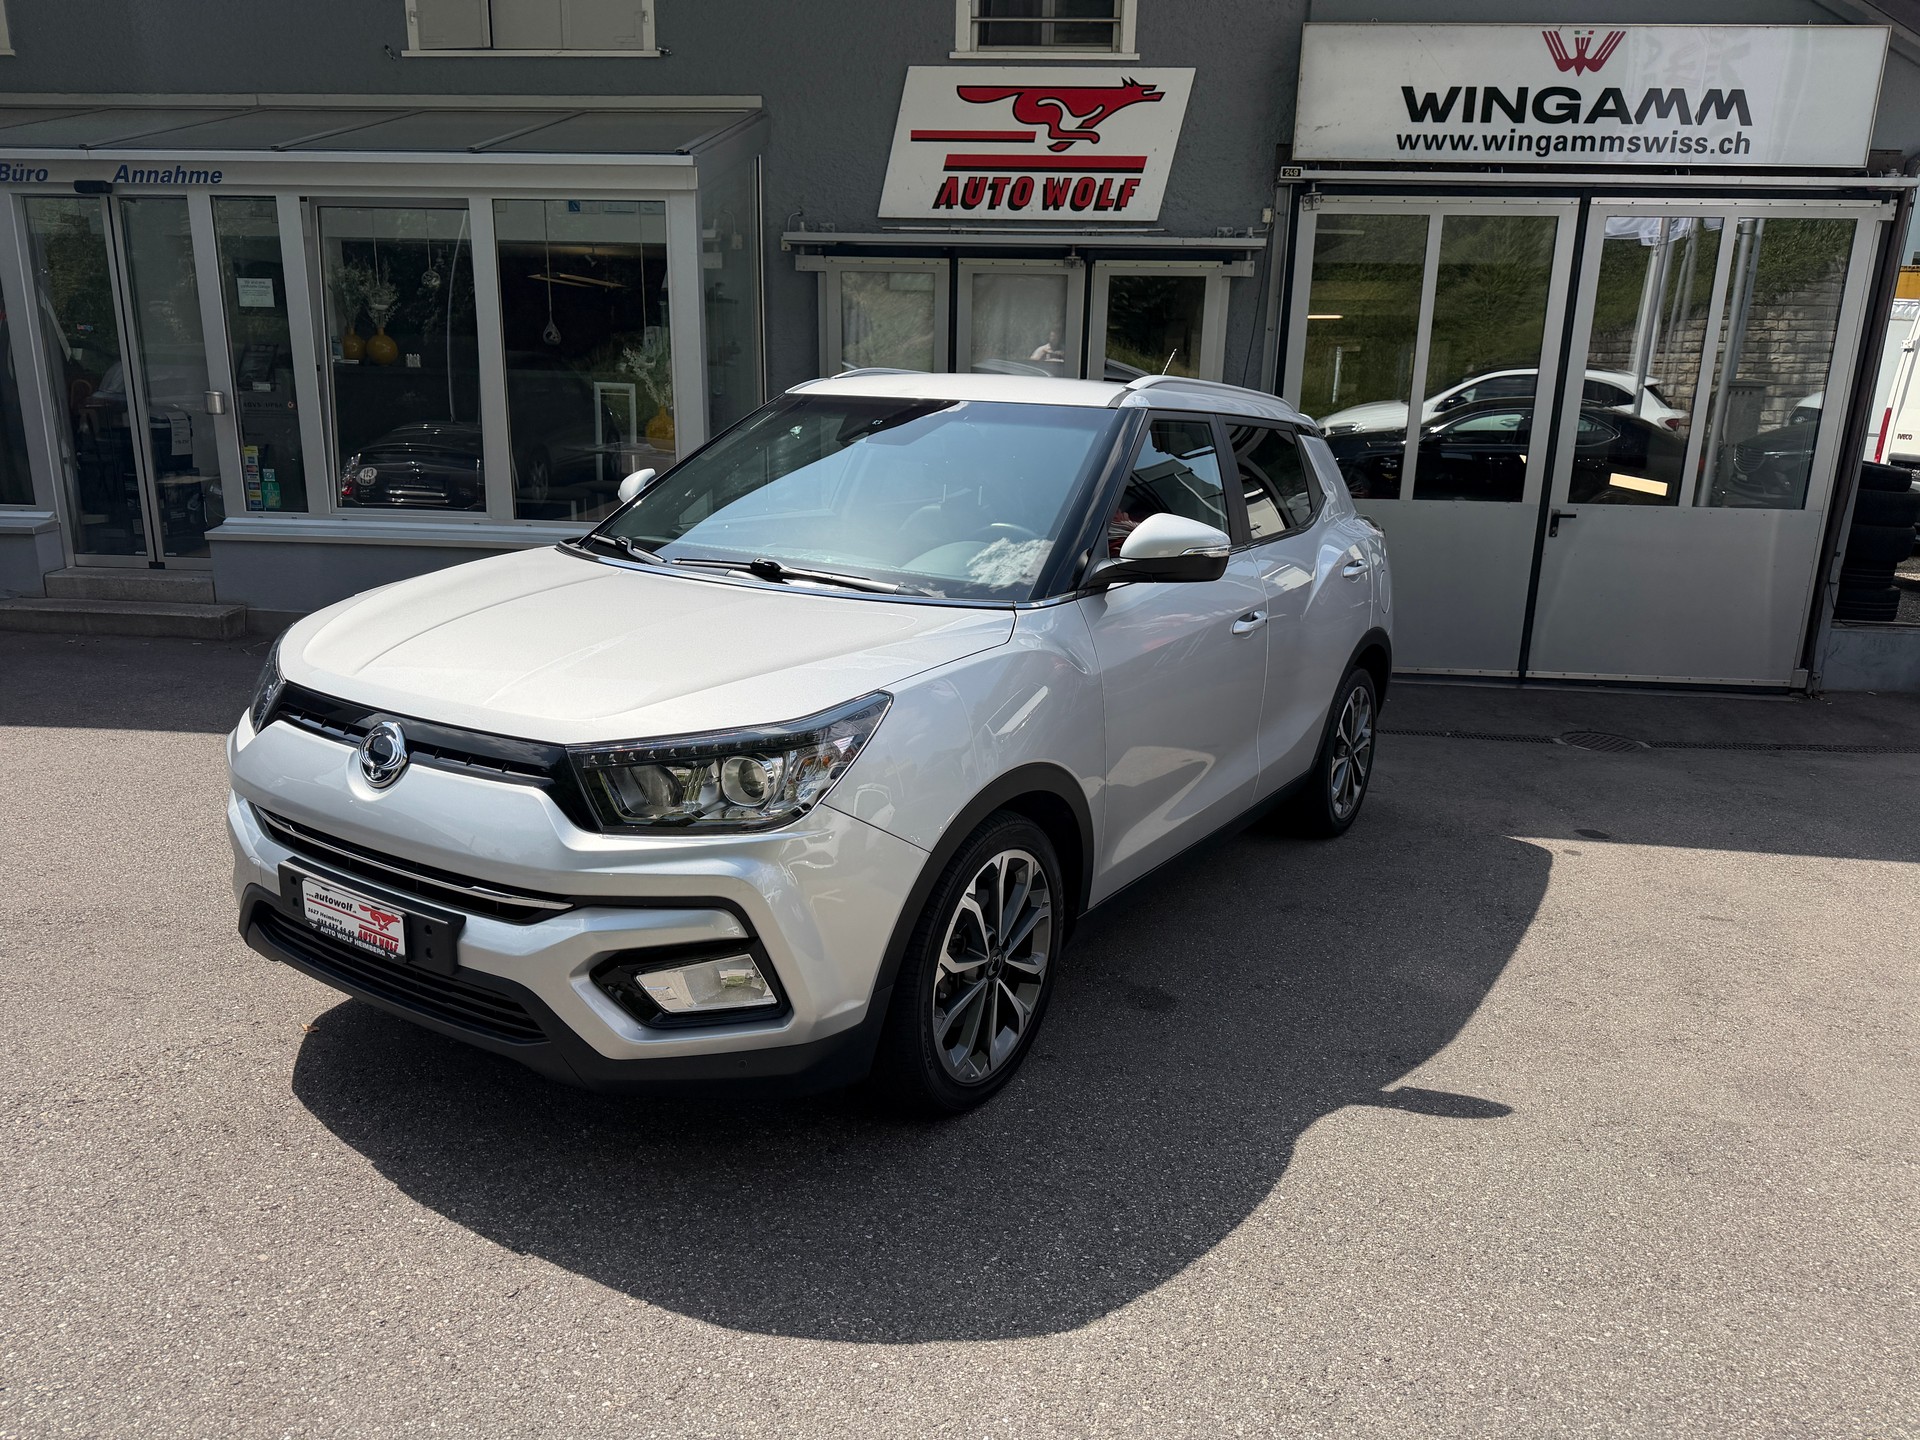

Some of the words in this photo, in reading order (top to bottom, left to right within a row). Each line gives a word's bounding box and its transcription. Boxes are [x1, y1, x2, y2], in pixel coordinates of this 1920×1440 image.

[1400, 85, 1753, 127] WINGAMM
[1396, 128, 1751, 158] www.wingammswiss.ch
[0, 163, 49, 182] Büro
[112, 164, 223, 184] Annahme
[931, 176, 1035, 211] AUTO
[1042, 176, 1142, 212] WOLF
[1896, 433, 1913, 441] IVECO
[306, 892, 357, 914] .autowolf.
[319, 911, 343, 926] Heimberg
[320, 925, 336, 937] AUTO
[336, 932, 354, 944] WOLF
[354, 939, 386, 957] HEIMBERG
[358, 930, 378, 945] AUTO
[378, 937, 399, 953] WOLF
